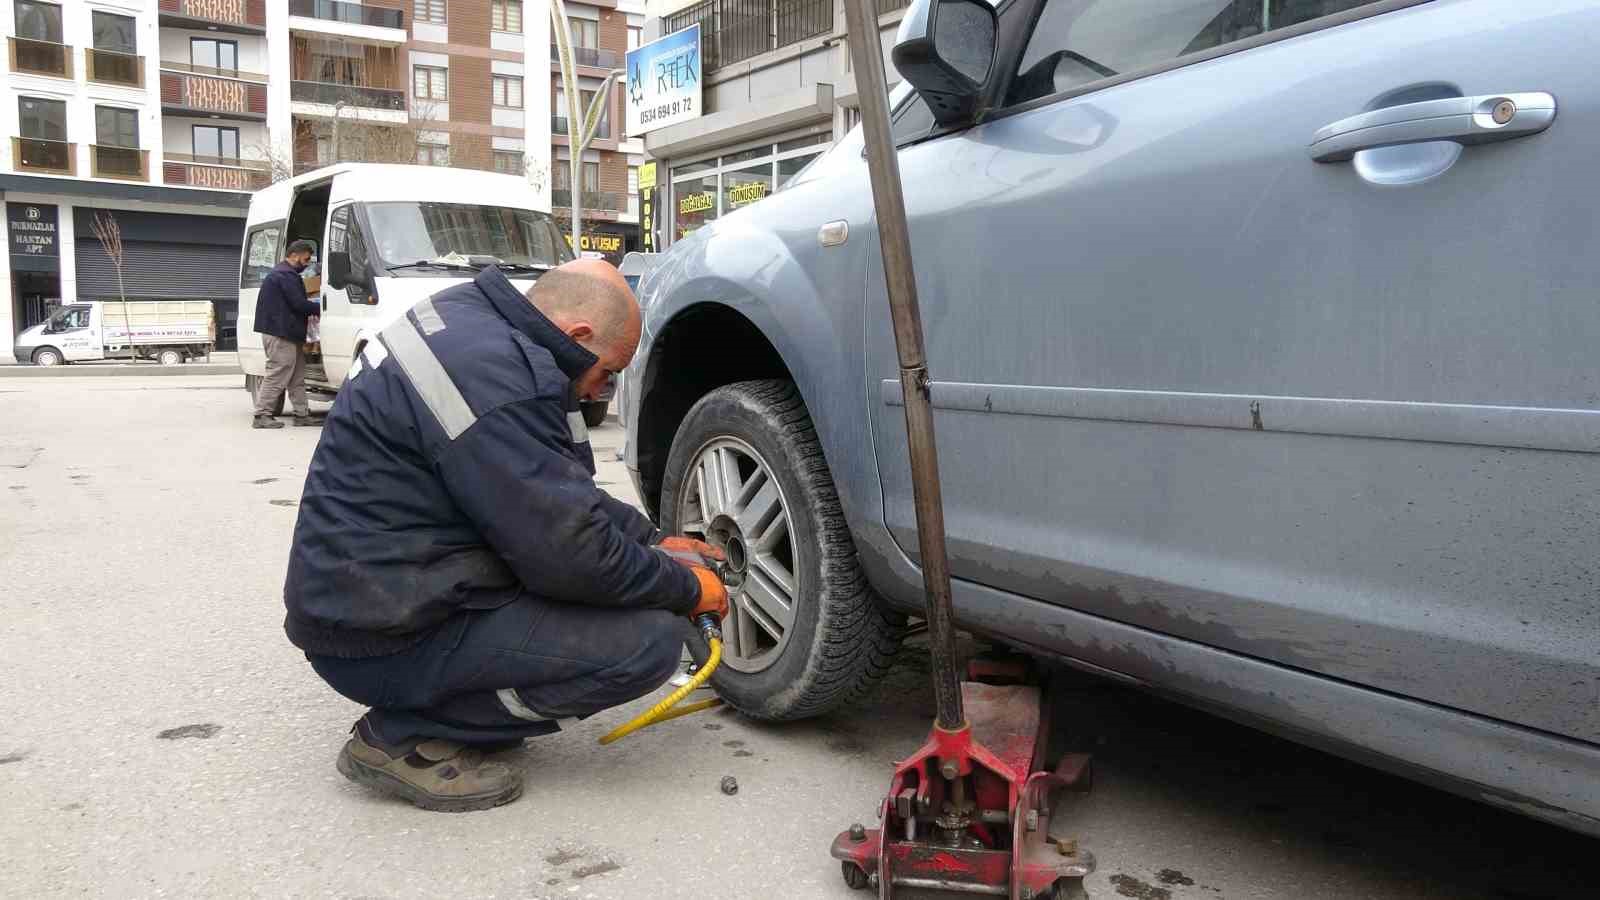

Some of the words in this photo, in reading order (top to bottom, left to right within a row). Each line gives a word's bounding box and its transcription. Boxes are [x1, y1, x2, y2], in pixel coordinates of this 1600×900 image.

[640, 108, 656, 125] 0534
[658, 102, 670, 119] 694
[672, 101, 680, 115] 91
[683, 97, 692, 112] 72
[591, 236, 621, 251] YUSUF
